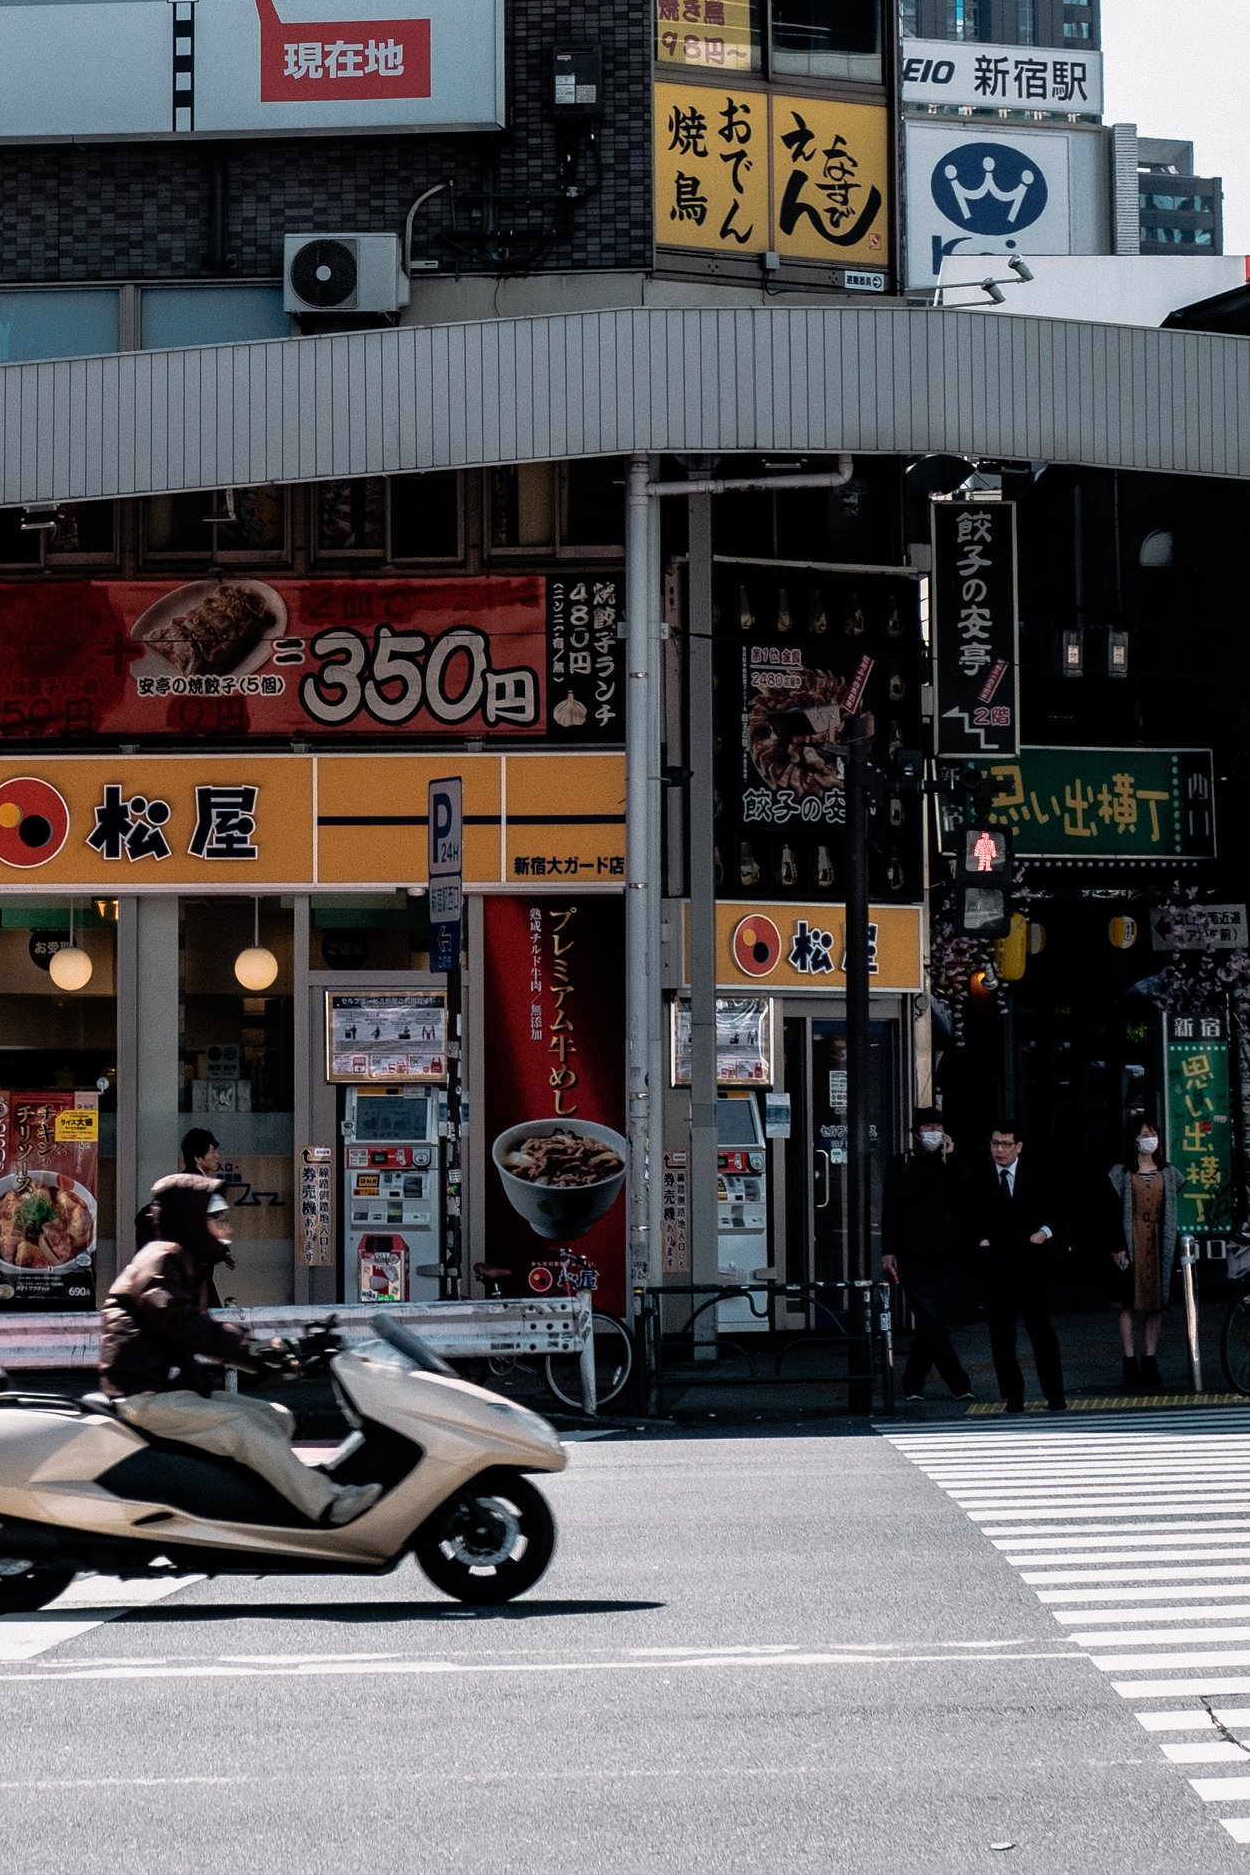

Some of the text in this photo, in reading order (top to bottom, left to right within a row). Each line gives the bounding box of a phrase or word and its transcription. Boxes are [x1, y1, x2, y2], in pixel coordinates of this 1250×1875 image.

[284, 40, 404, 81] 現在地
[903, 54, 1088, 103] EIO 新宿駅
[668, 106, 709, 226] 焼鳥
[718, 97, 754, 244] おでん
[569, 582, 591, 675] 480円
[956, 510, 993, 677] 餃子の安亭
[137, 676, 286, 697] 安亭の焼餃子(5個)
[303, 624, 538, 725] 350円
[593, 581, 617, 727] 焼餃子ランチ
[973, 706, 1011, 727] 2階
[86, 784, 260, 862] 松屋
[433, 792, 459, 864] P 24H
[1187, 773, 1210, 837] 西口
[514, 855, 626, 876] 新宿大ガード店
[547, 906, 578, 1116] プレミアム牛めし
[1174, 1017, 1221, 1038] 新宿
[14, 1104, 35, 1194] チリソース
[1181, 1053, 1222, 1223] 思い出横丁
[302, 1166, 317, 1263] 券売機あります
[663, 1172, 676, 1268] 券売機あります
